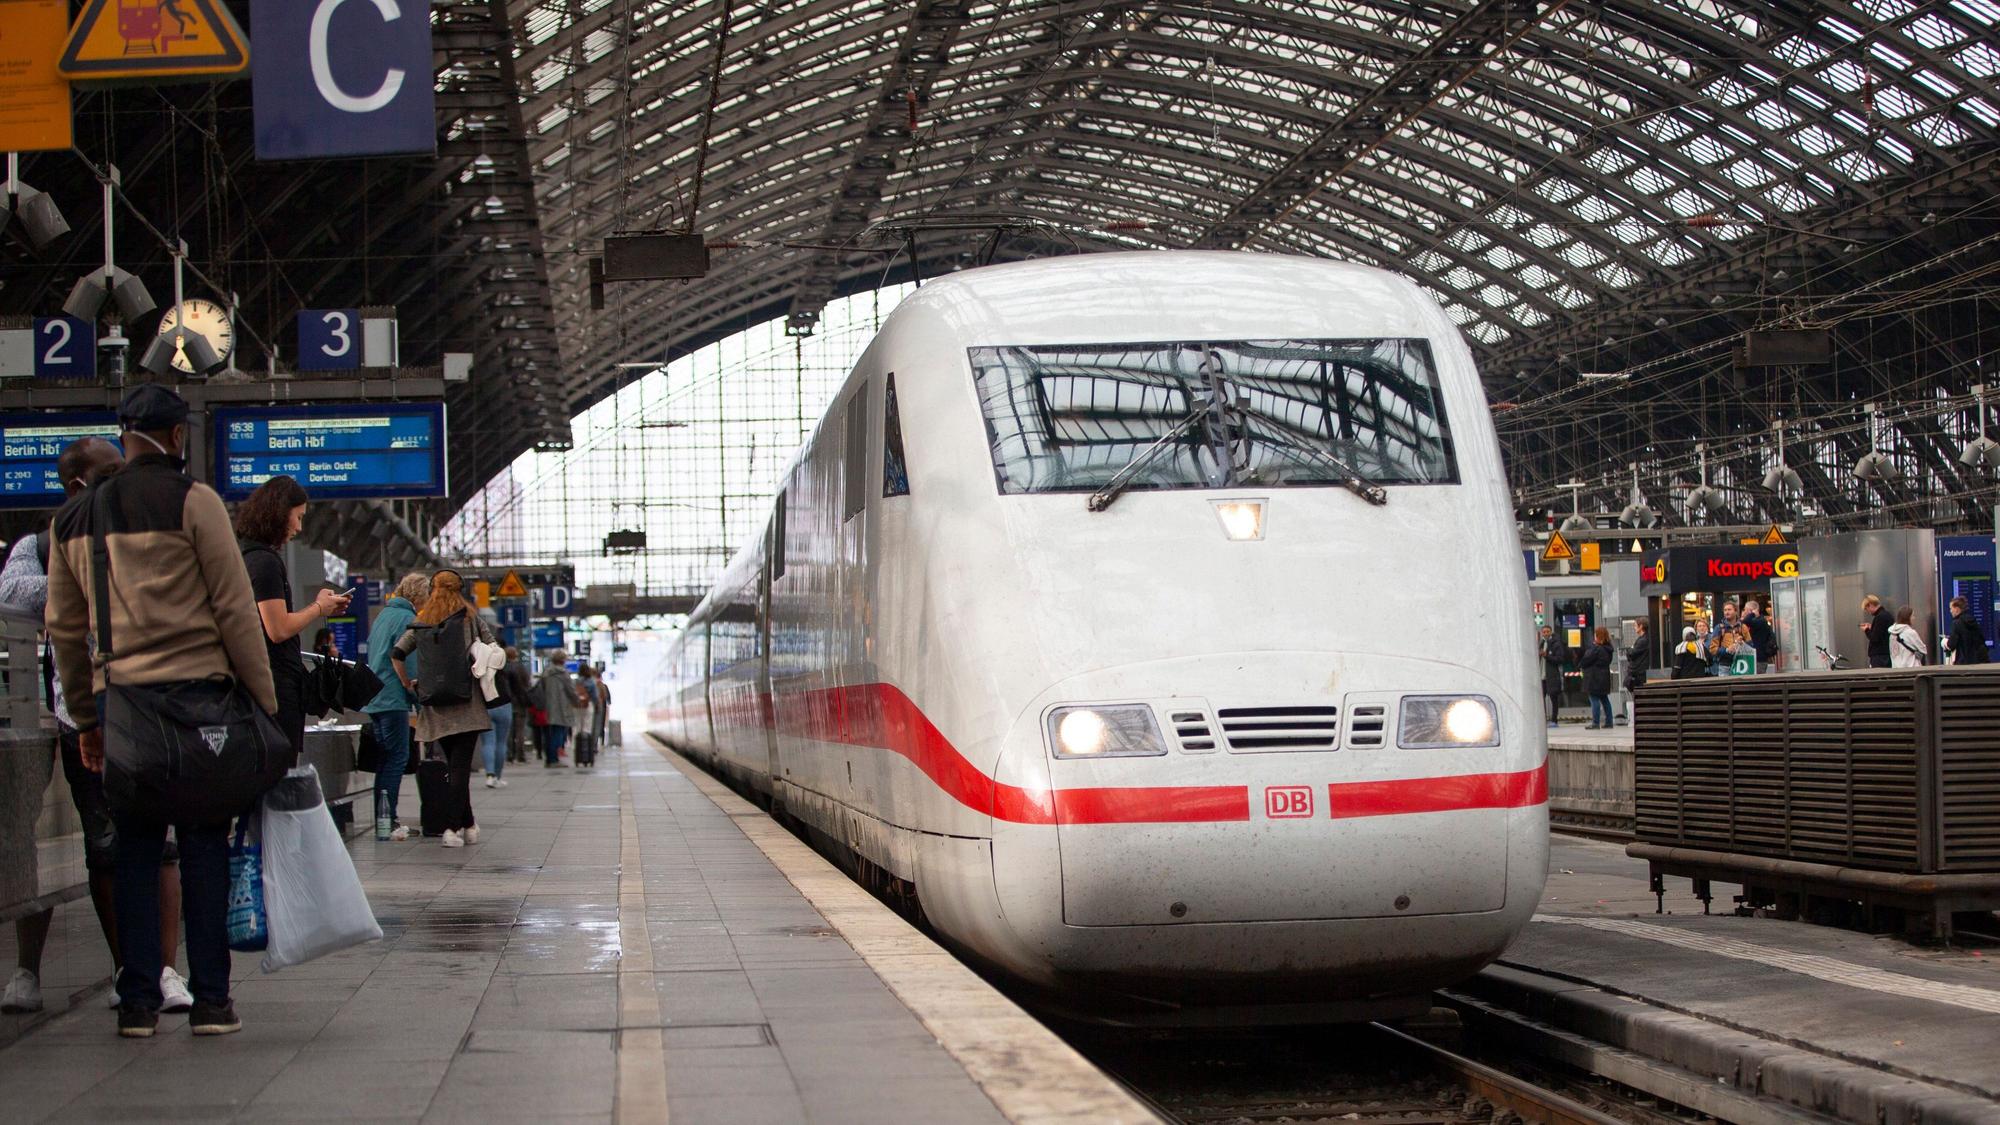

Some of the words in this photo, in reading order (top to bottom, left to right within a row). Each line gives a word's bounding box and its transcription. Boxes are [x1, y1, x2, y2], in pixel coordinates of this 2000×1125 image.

[310, 0, 406, 113] C
[43, 319, 72, 365] 2
[321, 311, 351, 357] 3
[5, 444, 37, 457] Berlin
[40, 443, 60, 455] Hbf
[269, 436, 302, 449] Berlin
[305, 435, 325, 448] Hbf
[309, 462, 332, 471] Berlin
[309, 473, 347, 482] Dortmund
[1707, 559, 1773, 579] Kamps
[552, 586, 570, 609] D
[1271, 791, 1308, 813] DB
